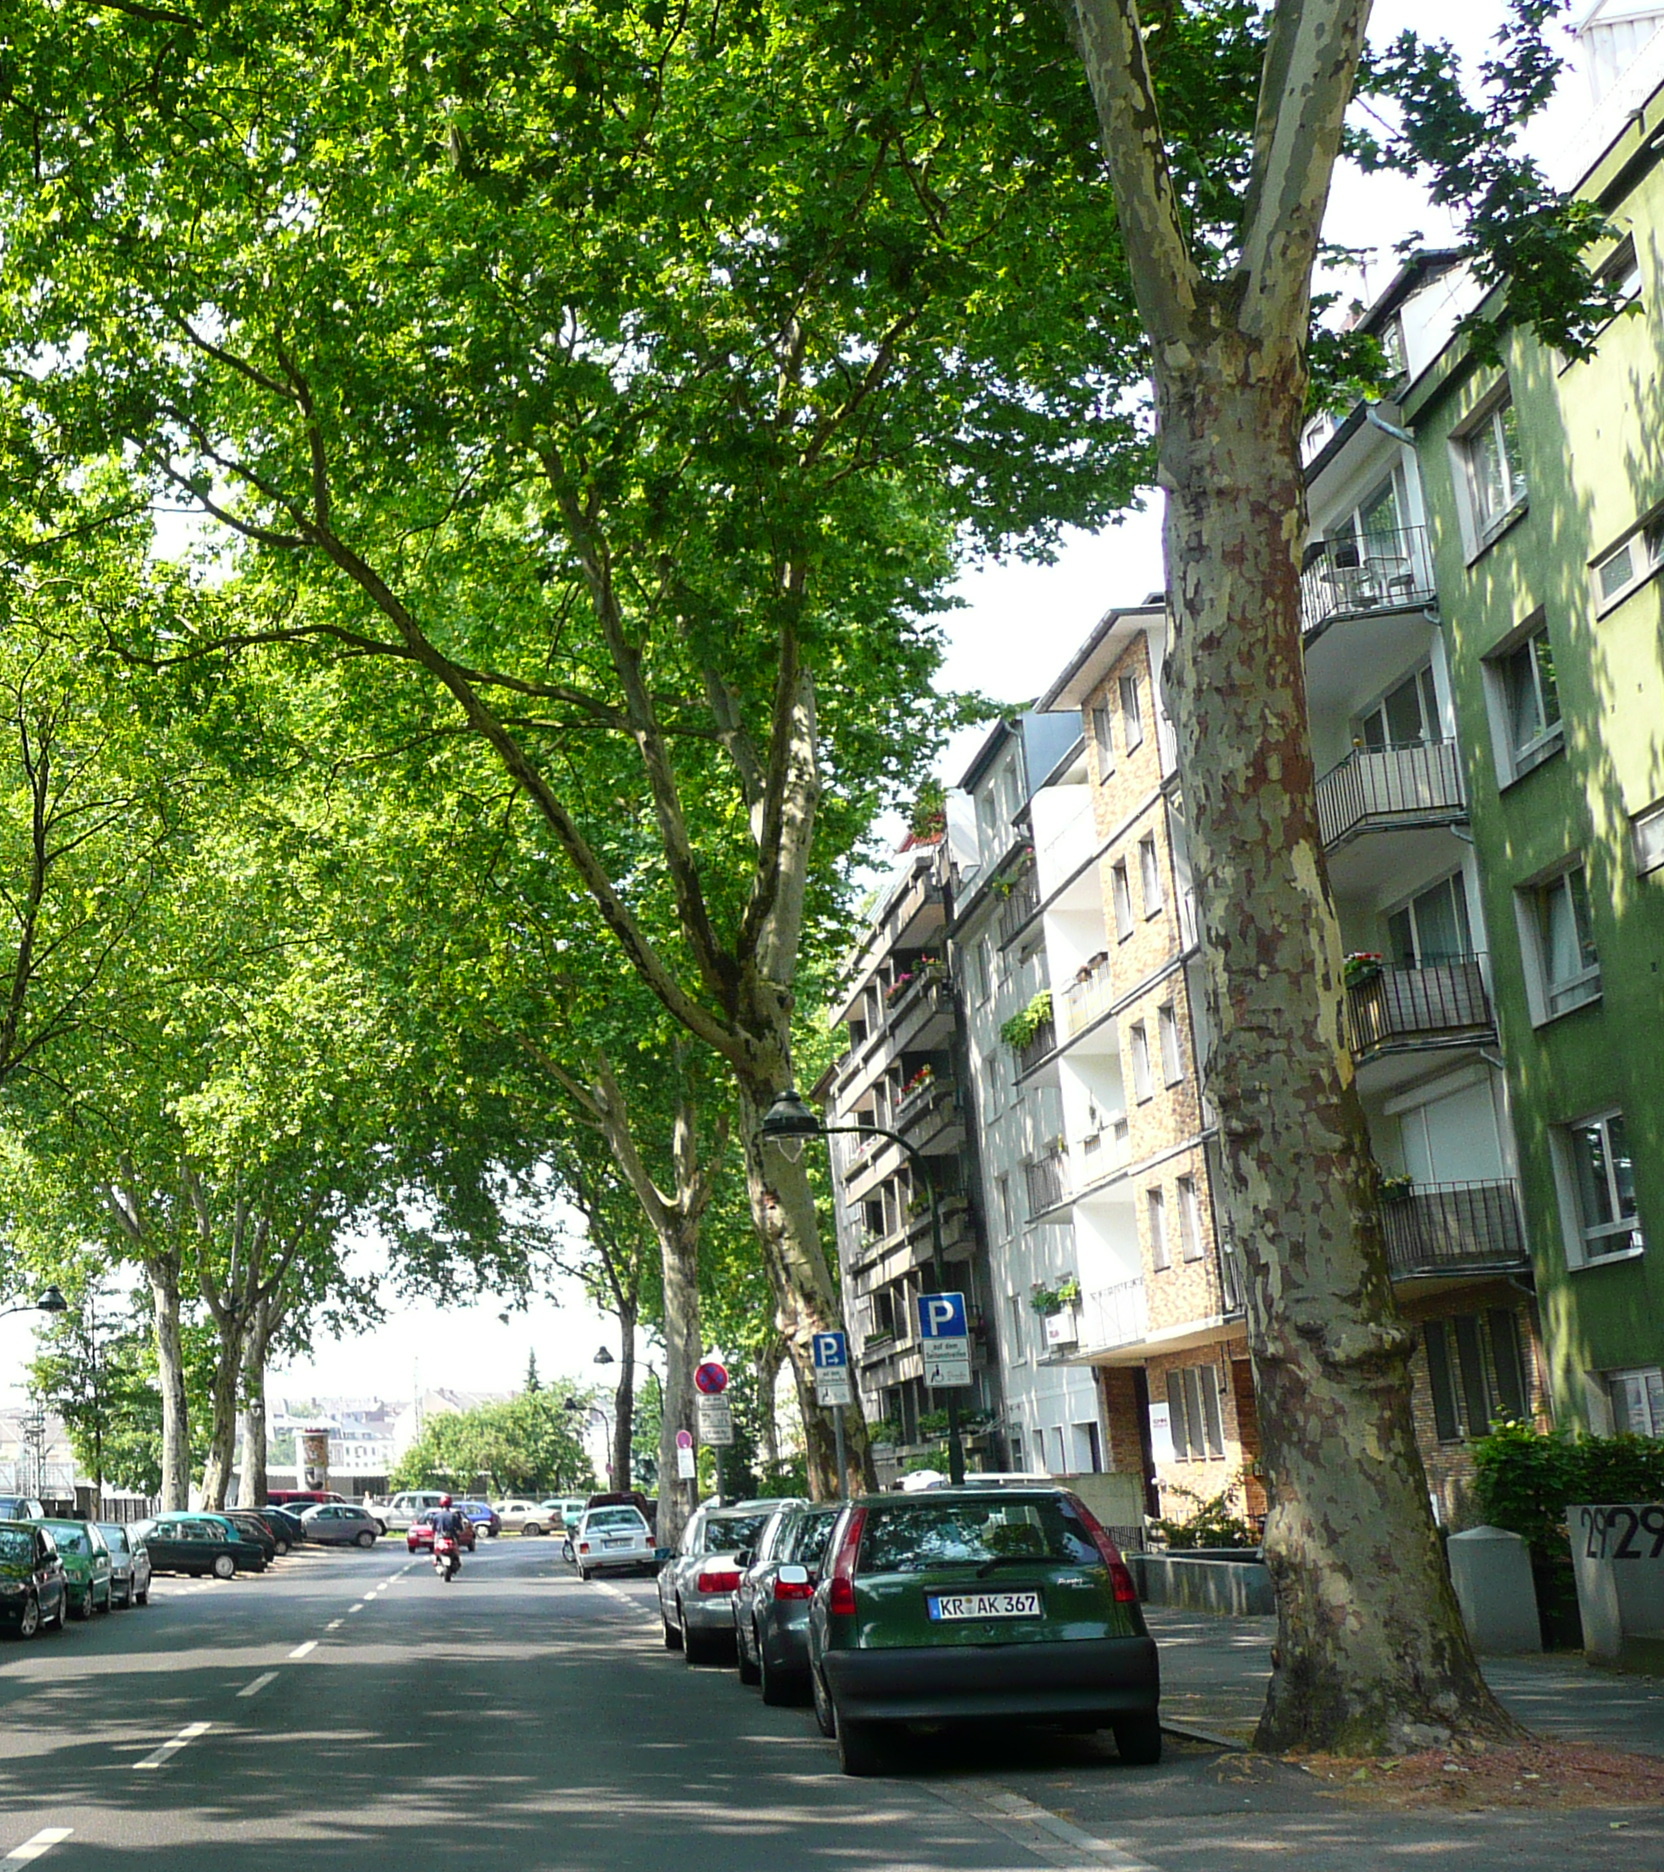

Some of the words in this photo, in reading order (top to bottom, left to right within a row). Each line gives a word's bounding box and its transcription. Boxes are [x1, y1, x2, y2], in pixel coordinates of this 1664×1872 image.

[928, 1300, 954, 1336] P
[819, 1336, 838, 1367] P
[1581, 1507, 1607, 1559] 29
[1607, 1505, 1664, 1559] 29
[940, 1598, 964, 1616] KR
[977, 1596, 1000, 1614] AK
[1004, 1595, 1035, 1613] 367
